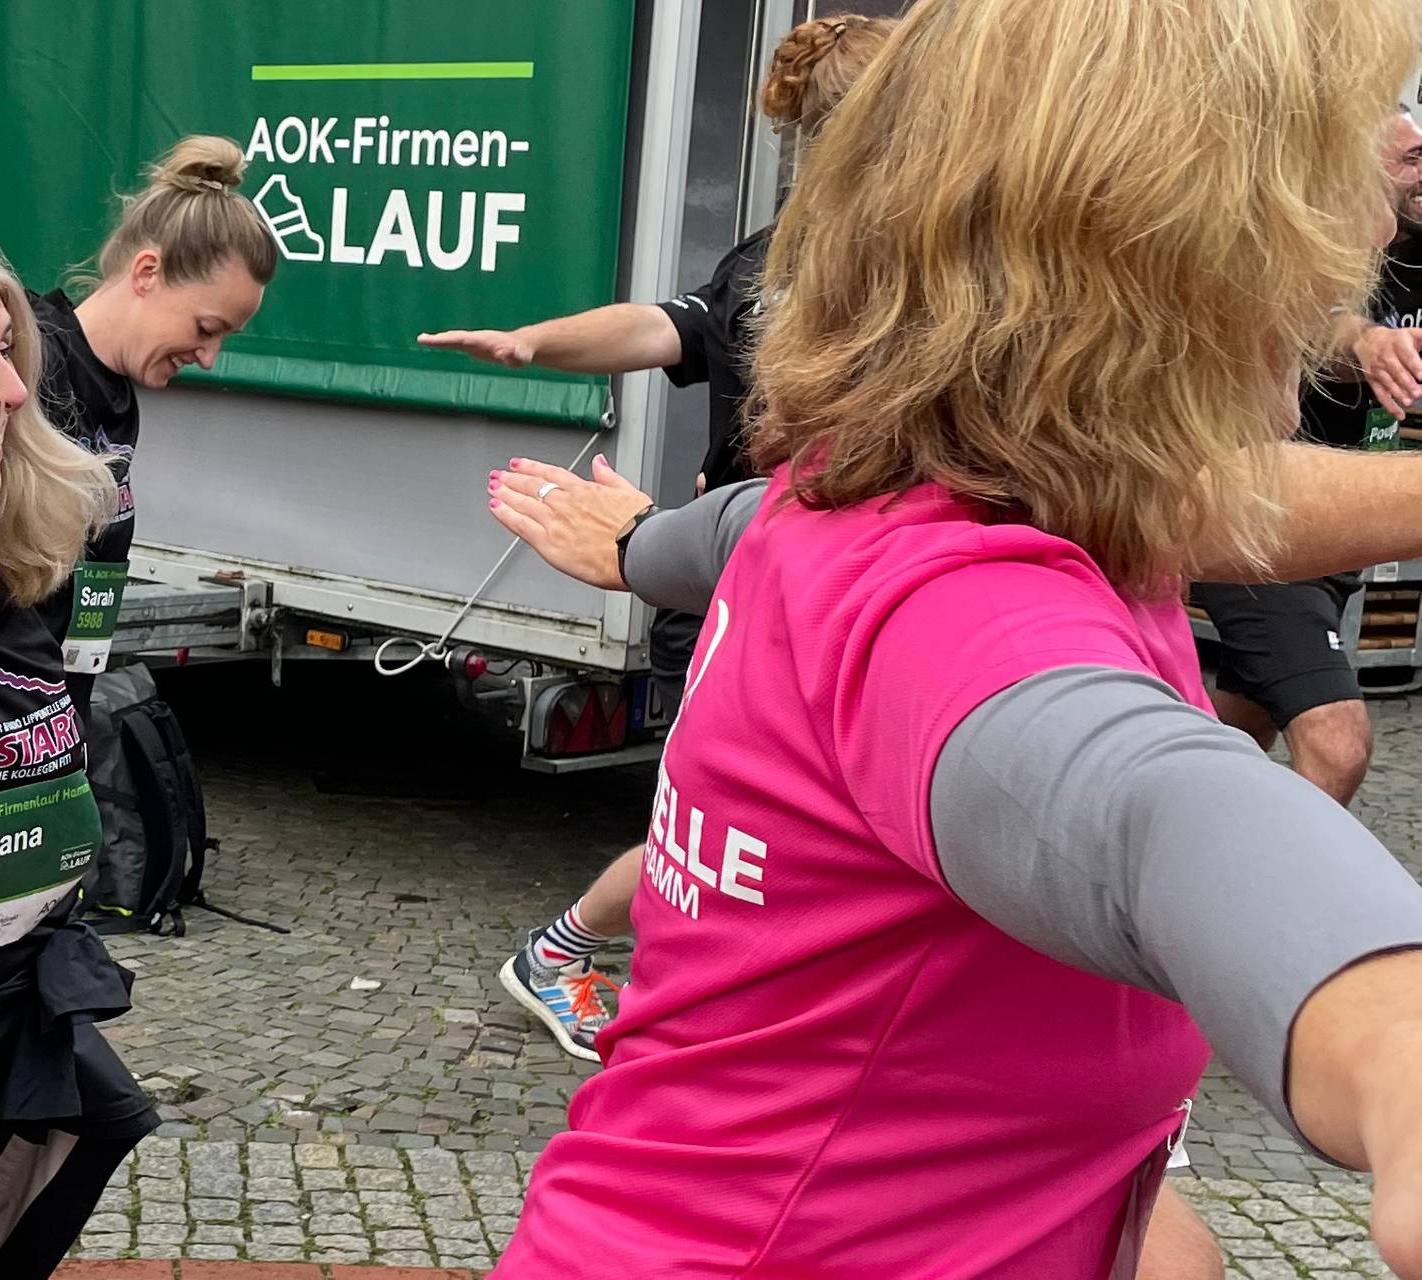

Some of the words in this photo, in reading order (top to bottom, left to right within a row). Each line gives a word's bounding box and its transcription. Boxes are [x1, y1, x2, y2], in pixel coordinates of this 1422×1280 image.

[246, 115, 529, 168] AOK-Firmen-
[329, 187, 527, 272] LAUF
[80, 586, 115, 607] Sarah
[76, 611, 104, 629] 5988
[10, 759, 59, 780] KOLLEGEN
[644, 838, 700, 921] HAMM
